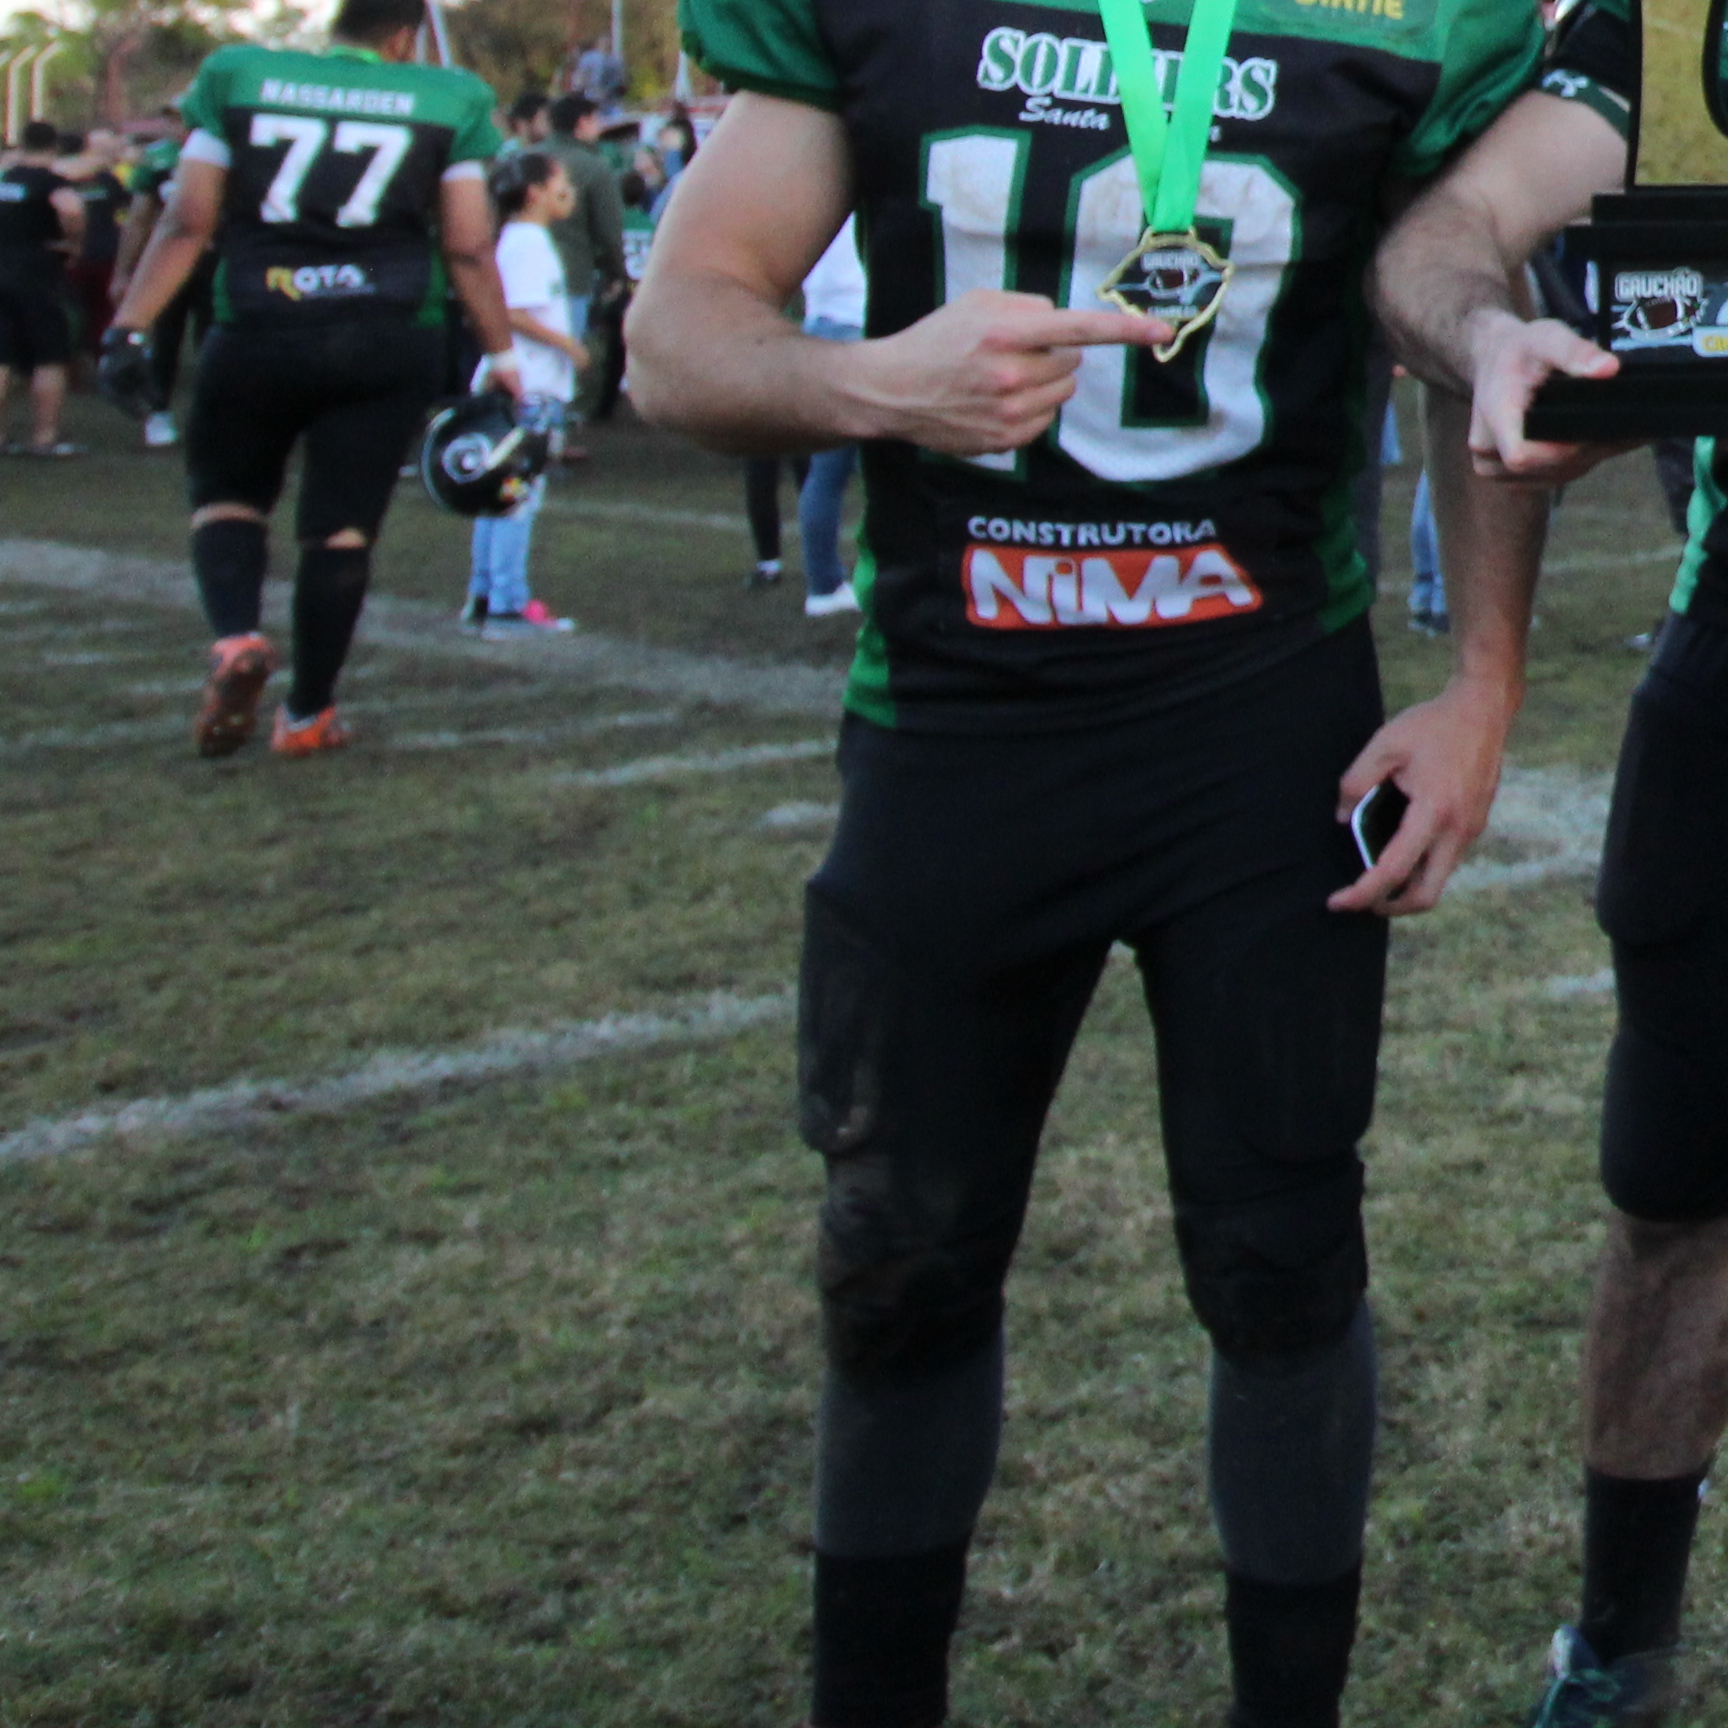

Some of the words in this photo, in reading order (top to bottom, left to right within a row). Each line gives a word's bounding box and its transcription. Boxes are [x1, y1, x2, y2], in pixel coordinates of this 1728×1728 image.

[1017, 95, 1111, 131] Santa
[249, 112, 413, 229] 77
[922, 128, 1303, 484] 10
[967, 515, 1217, 548] CONSTRUTORA
